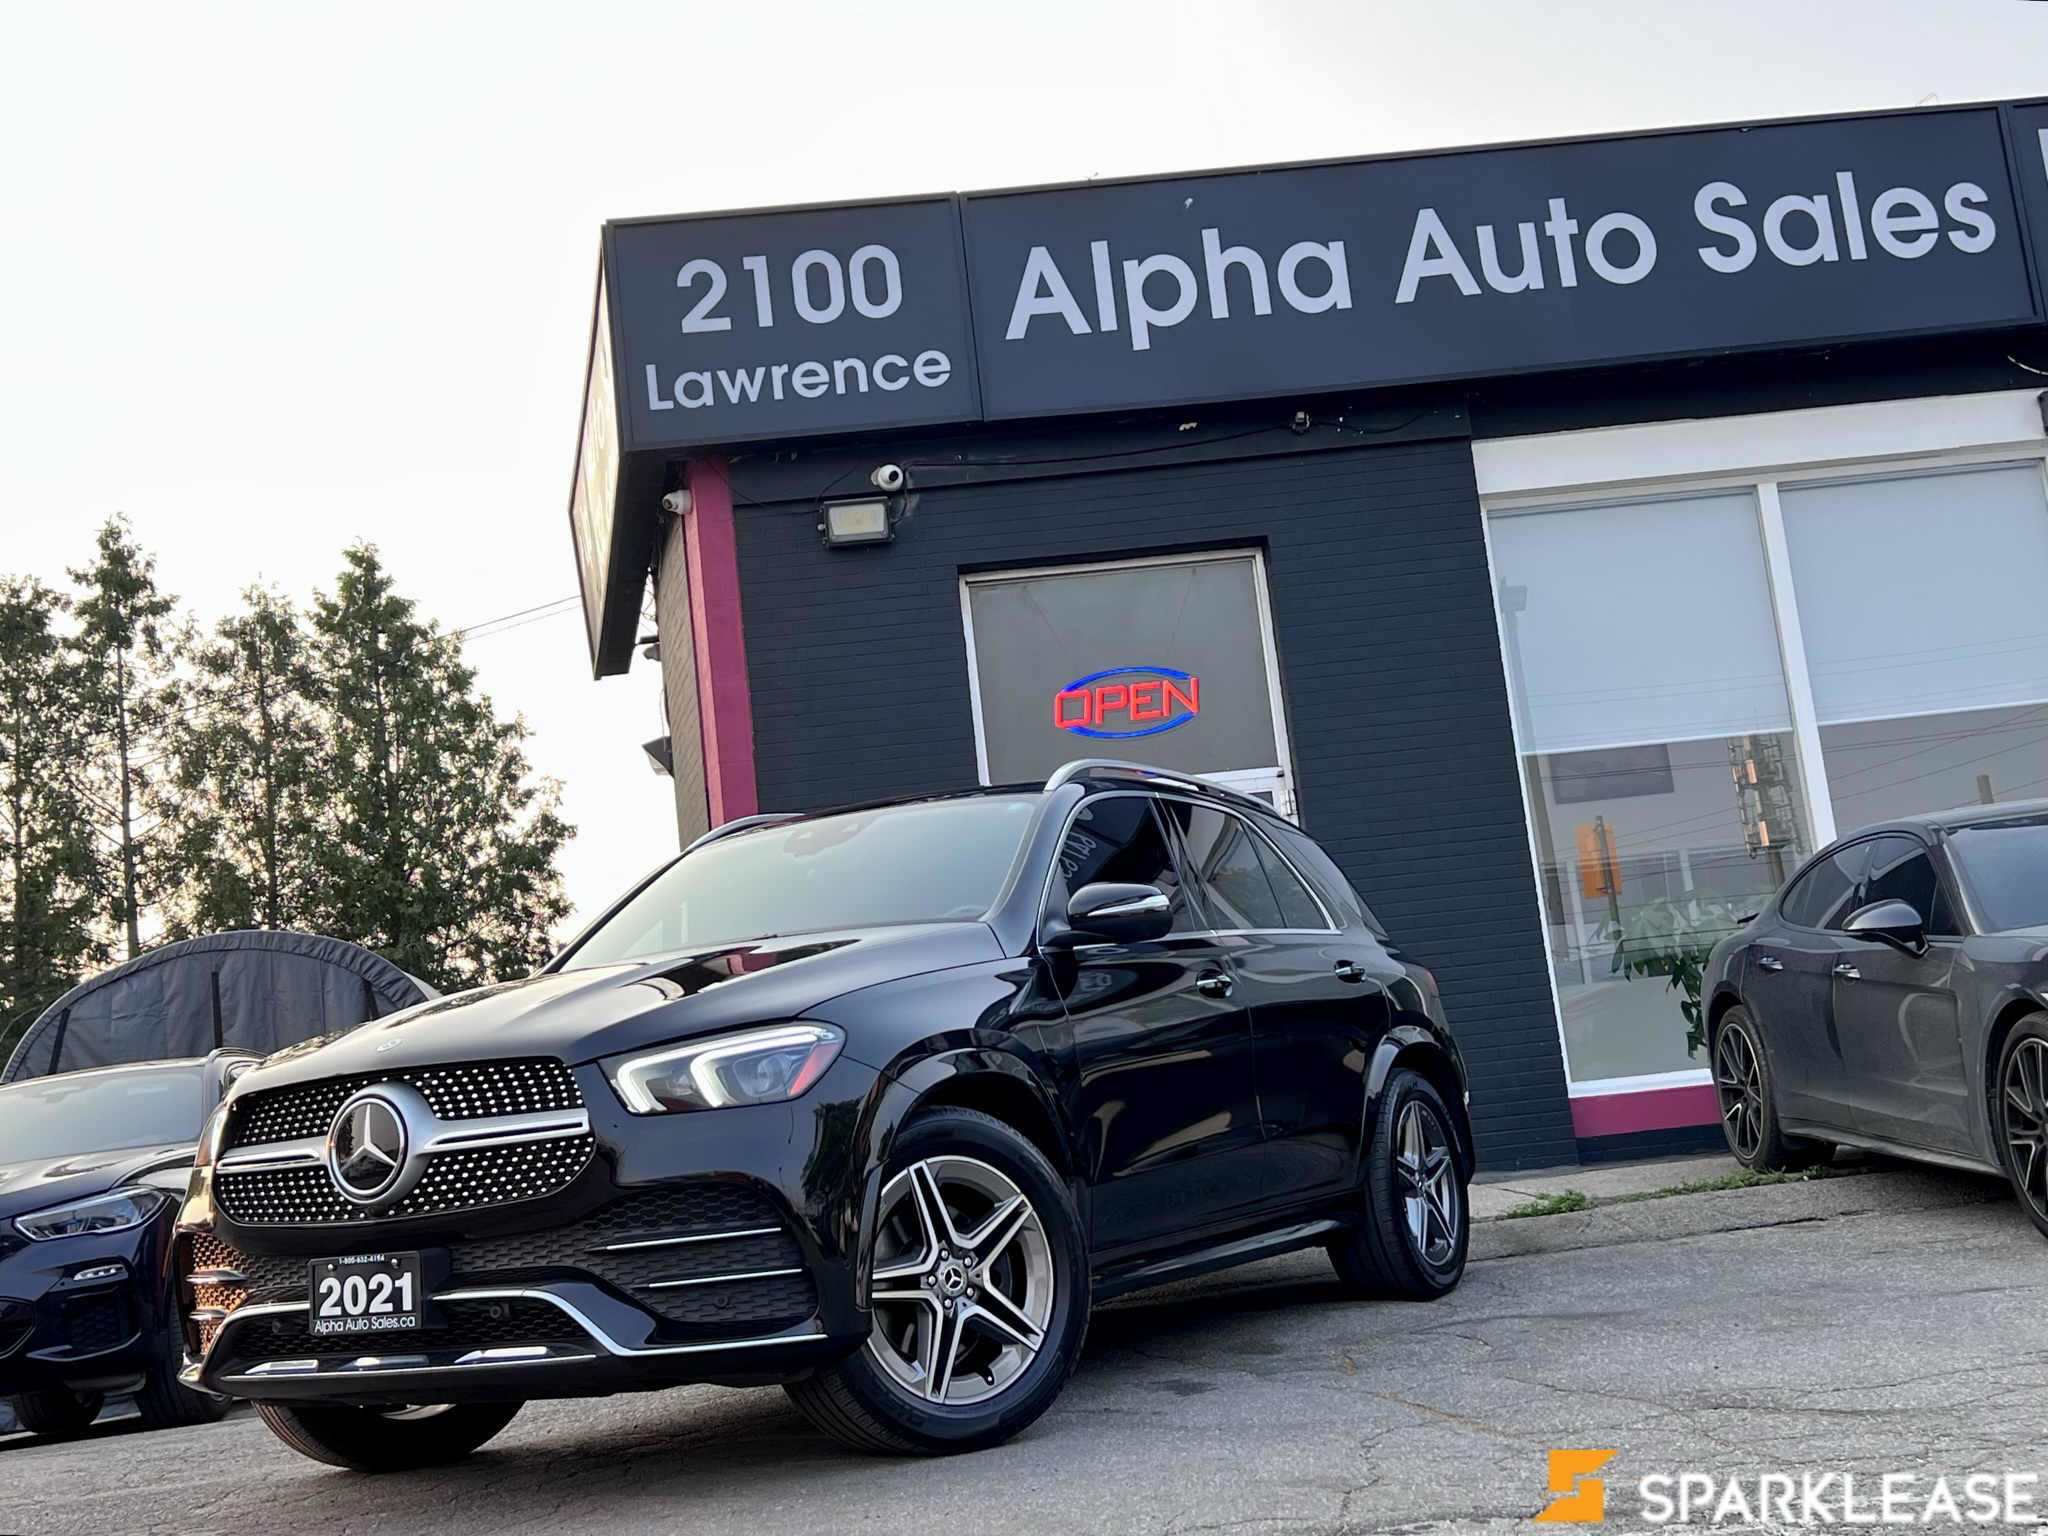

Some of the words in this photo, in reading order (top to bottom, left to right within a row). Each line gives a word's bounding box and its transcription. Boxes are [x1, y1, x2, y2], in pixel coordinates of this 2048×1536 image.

[676, 244, 902, 333] 2100
[1005, 227, 1352, 350] Alpha
[1395, 198, 1657, 304] Auto
[1693, 171, 1996, 273] Sales
[646, 349, 951, 411] Lawrence
[1055, 677, 1199, 729] OPEN
[319, 1271, 413, 1317] 2021
[314, 1318, 344, 1336] Alpha
[345, 1318, 370, 1331] Auto
[371, 1315, 416, 1330] Sales.ca
